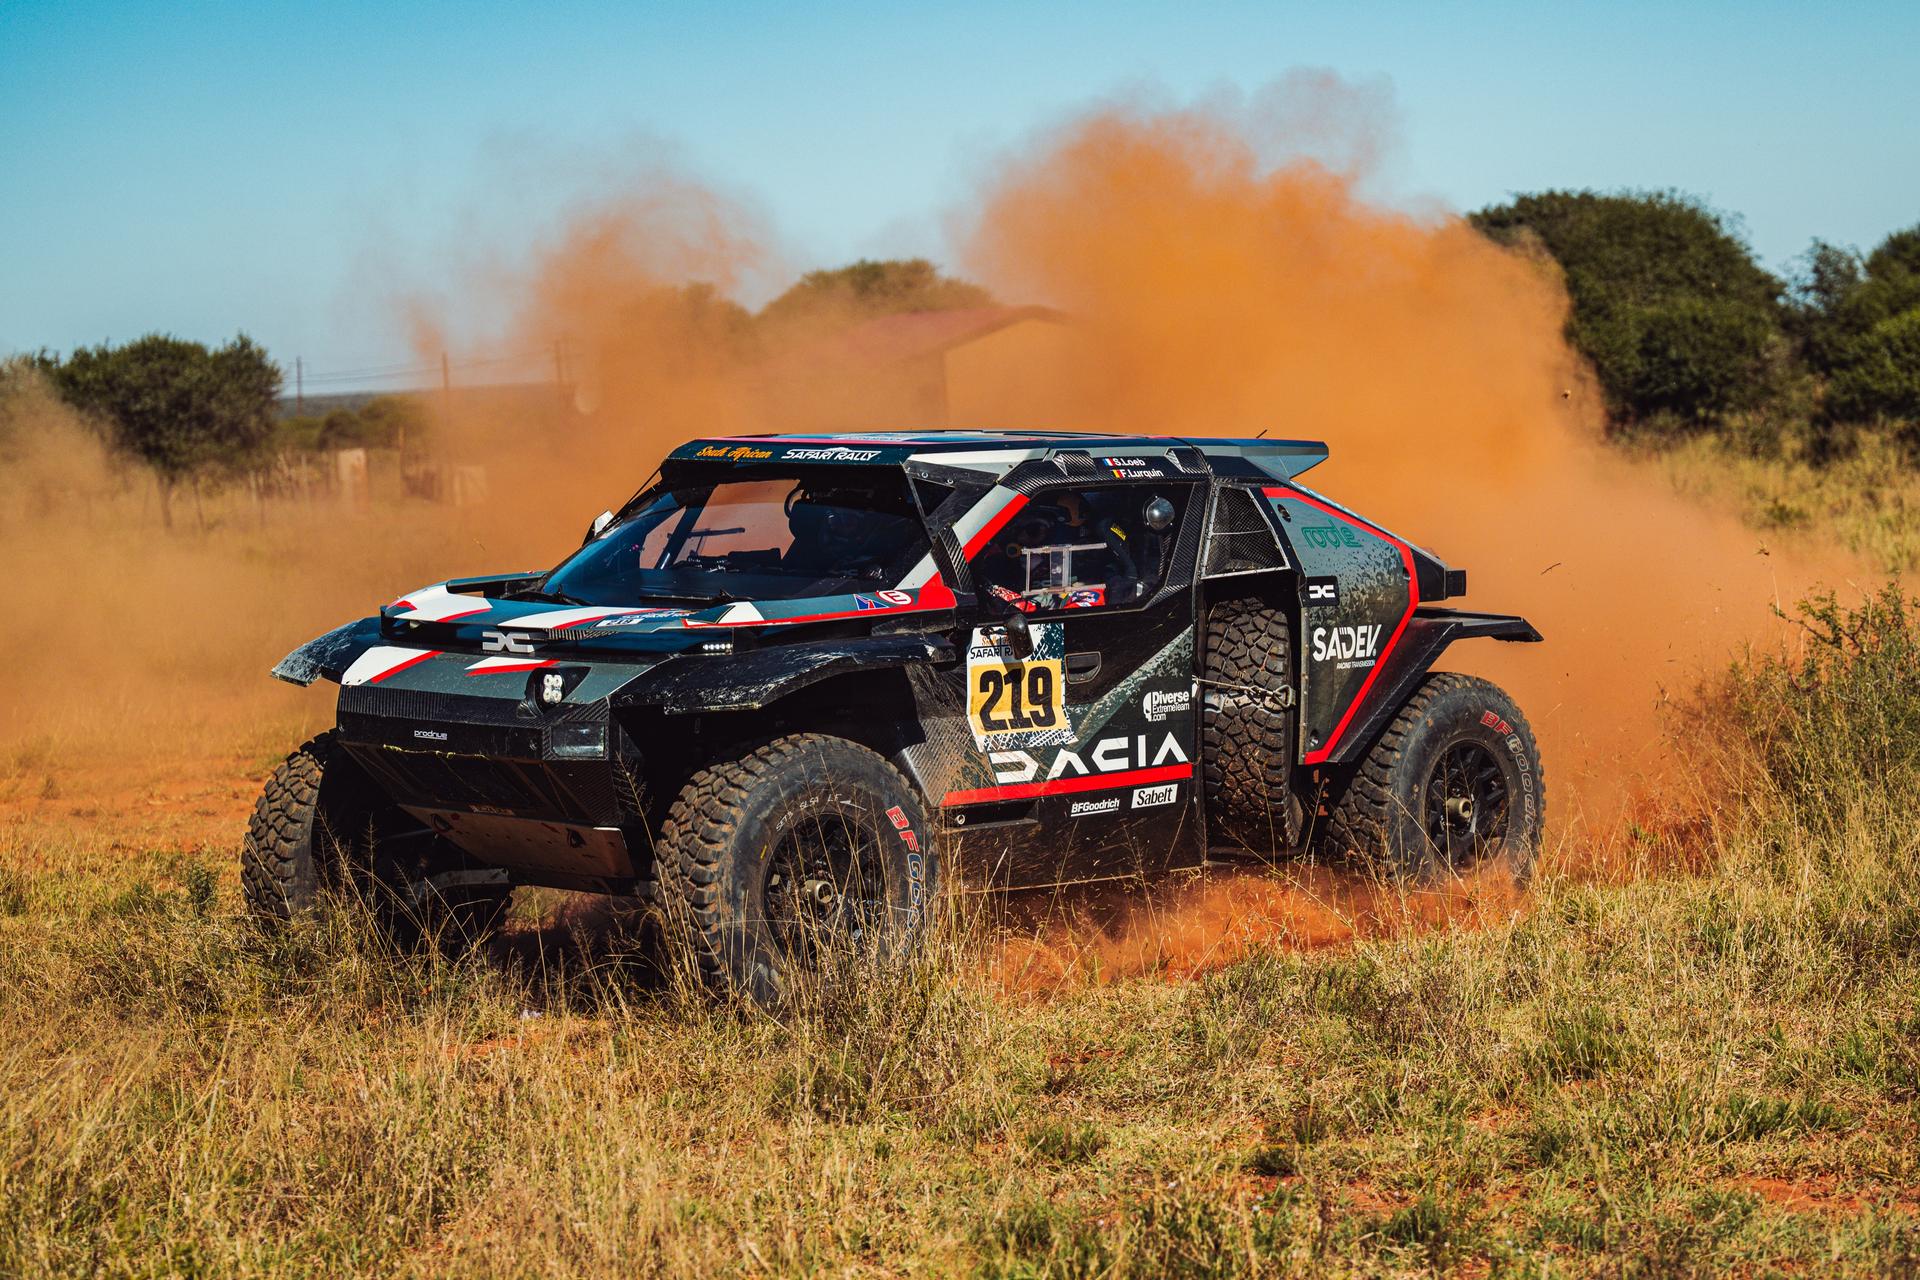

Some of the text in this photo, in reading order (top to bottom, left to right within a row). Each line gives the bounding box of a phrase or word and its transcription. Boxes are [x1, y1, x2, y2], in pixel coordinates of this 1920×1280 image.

[781, 448, 835, 460] SAFARI
[834, 449, 882, 461] RALLY
[1113, 458, 1146, 466] S.Loeb
[1121, 468, 1164, 479] F.Lurquin
[1312, 624, 1382, 662] SADEV
[979, 666, 1057, 732] 219
[1152, 690, 1190, 704] Diverse
[1152, 702, 1190, 714] ExtremeTeam
[988, 731, 1189, 784] DACIA
[1136, 786, 1173, 806] Sabelt
[1071, 797, 1120, 814] BFGoodrich
